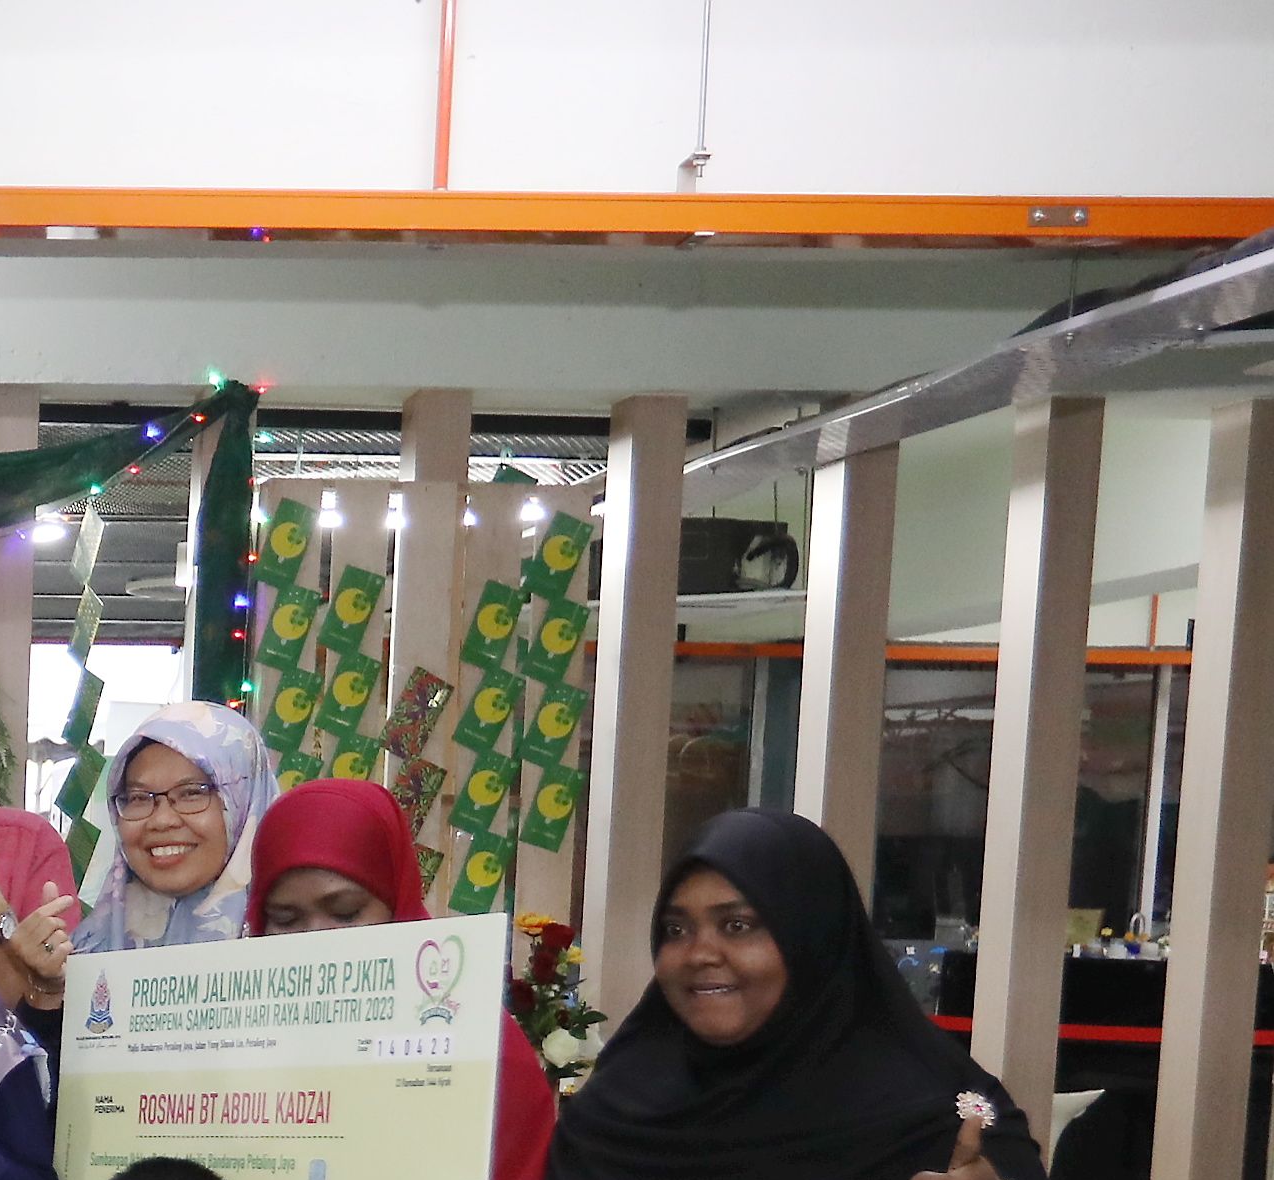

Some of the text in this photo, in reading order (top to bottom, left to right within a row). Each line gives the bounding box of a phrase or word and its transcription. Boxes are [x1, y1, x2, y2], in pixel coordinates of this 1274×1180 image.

[131, 958, 394, 1007] PROGRAM JALINAN KASIH 3R PJKITA
[128, 995, 393, 1032] BERSEMPENA SAMBUTAN HARI RAYA AIDILFITRI 2023
[138, 1090, 330, 1124] ROSNAH BT ABDUL KADZAI
